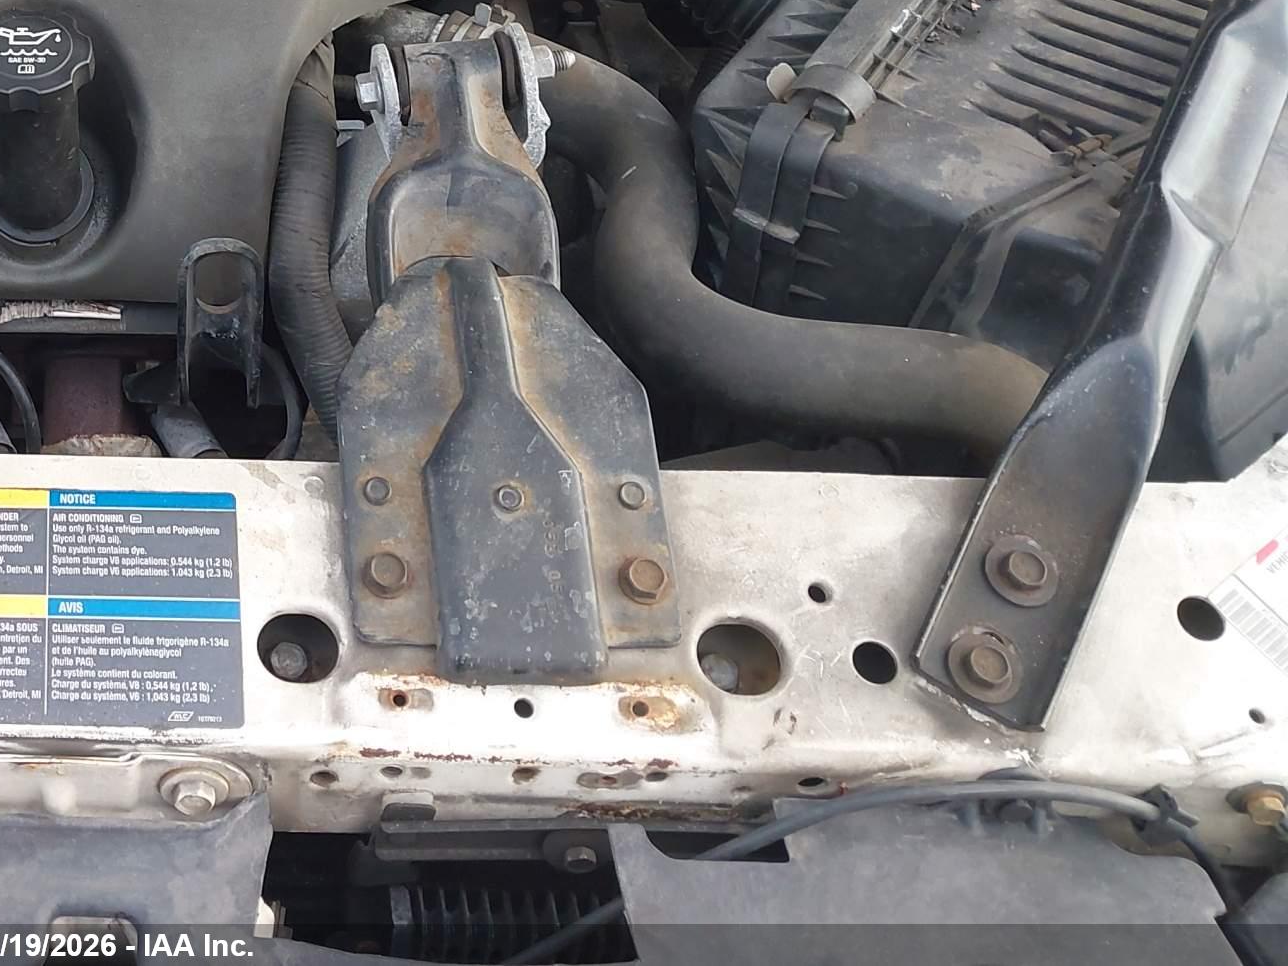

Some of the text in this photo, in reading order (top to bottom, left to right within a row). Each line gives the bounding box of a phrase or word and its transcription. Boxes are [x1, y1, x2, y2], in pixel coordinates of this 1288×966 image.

[60, 494, 95, 504] NOTICE
[53, 513, 124, 523] AIR CONDITIONING
[20, 523, 28, 531] to
[53, 524, 67, 532] Use
[69, 525, 84, 534] only
[115, 525, 155, 535] refrigerant
[157, 526, 171, 534] and
[172, 525, 220, 537] Polyalkylene
[77, 535, 86, 543] oil
[88, 534, 106, 544] (PAG
[53, 544, 147, 556] The system contains dye.
[52, 555, 80, 565] System
[82, 556, 108, 566] charge
[121, 556, 169, 567] applications:
[194, 558, 204, 568] kg
[6, 565, 32, 574] Detroit,
[34, 565, 43, 574] MI
[52, 566, 80, 576] System
[82, 567, 108, 577] charge
[121, 567, 169, 577] applications:
[194, 569, 204, 578] kg
[59, 602, 83, 613] AVIS
[16, 623, 38, 632] SOUS
[52, 623, 105, 633] CLIMATISEUR
[32, 634, 42, 643] du
[52, 657, 74, 666] (huile
[51, 668, 61, 677] Le
[97, 669, 129, 678] contient
[131, 670, 142, 678] du
[2, 689, 30, 699] Detroit,
[31, 690, 41, 699] MI
